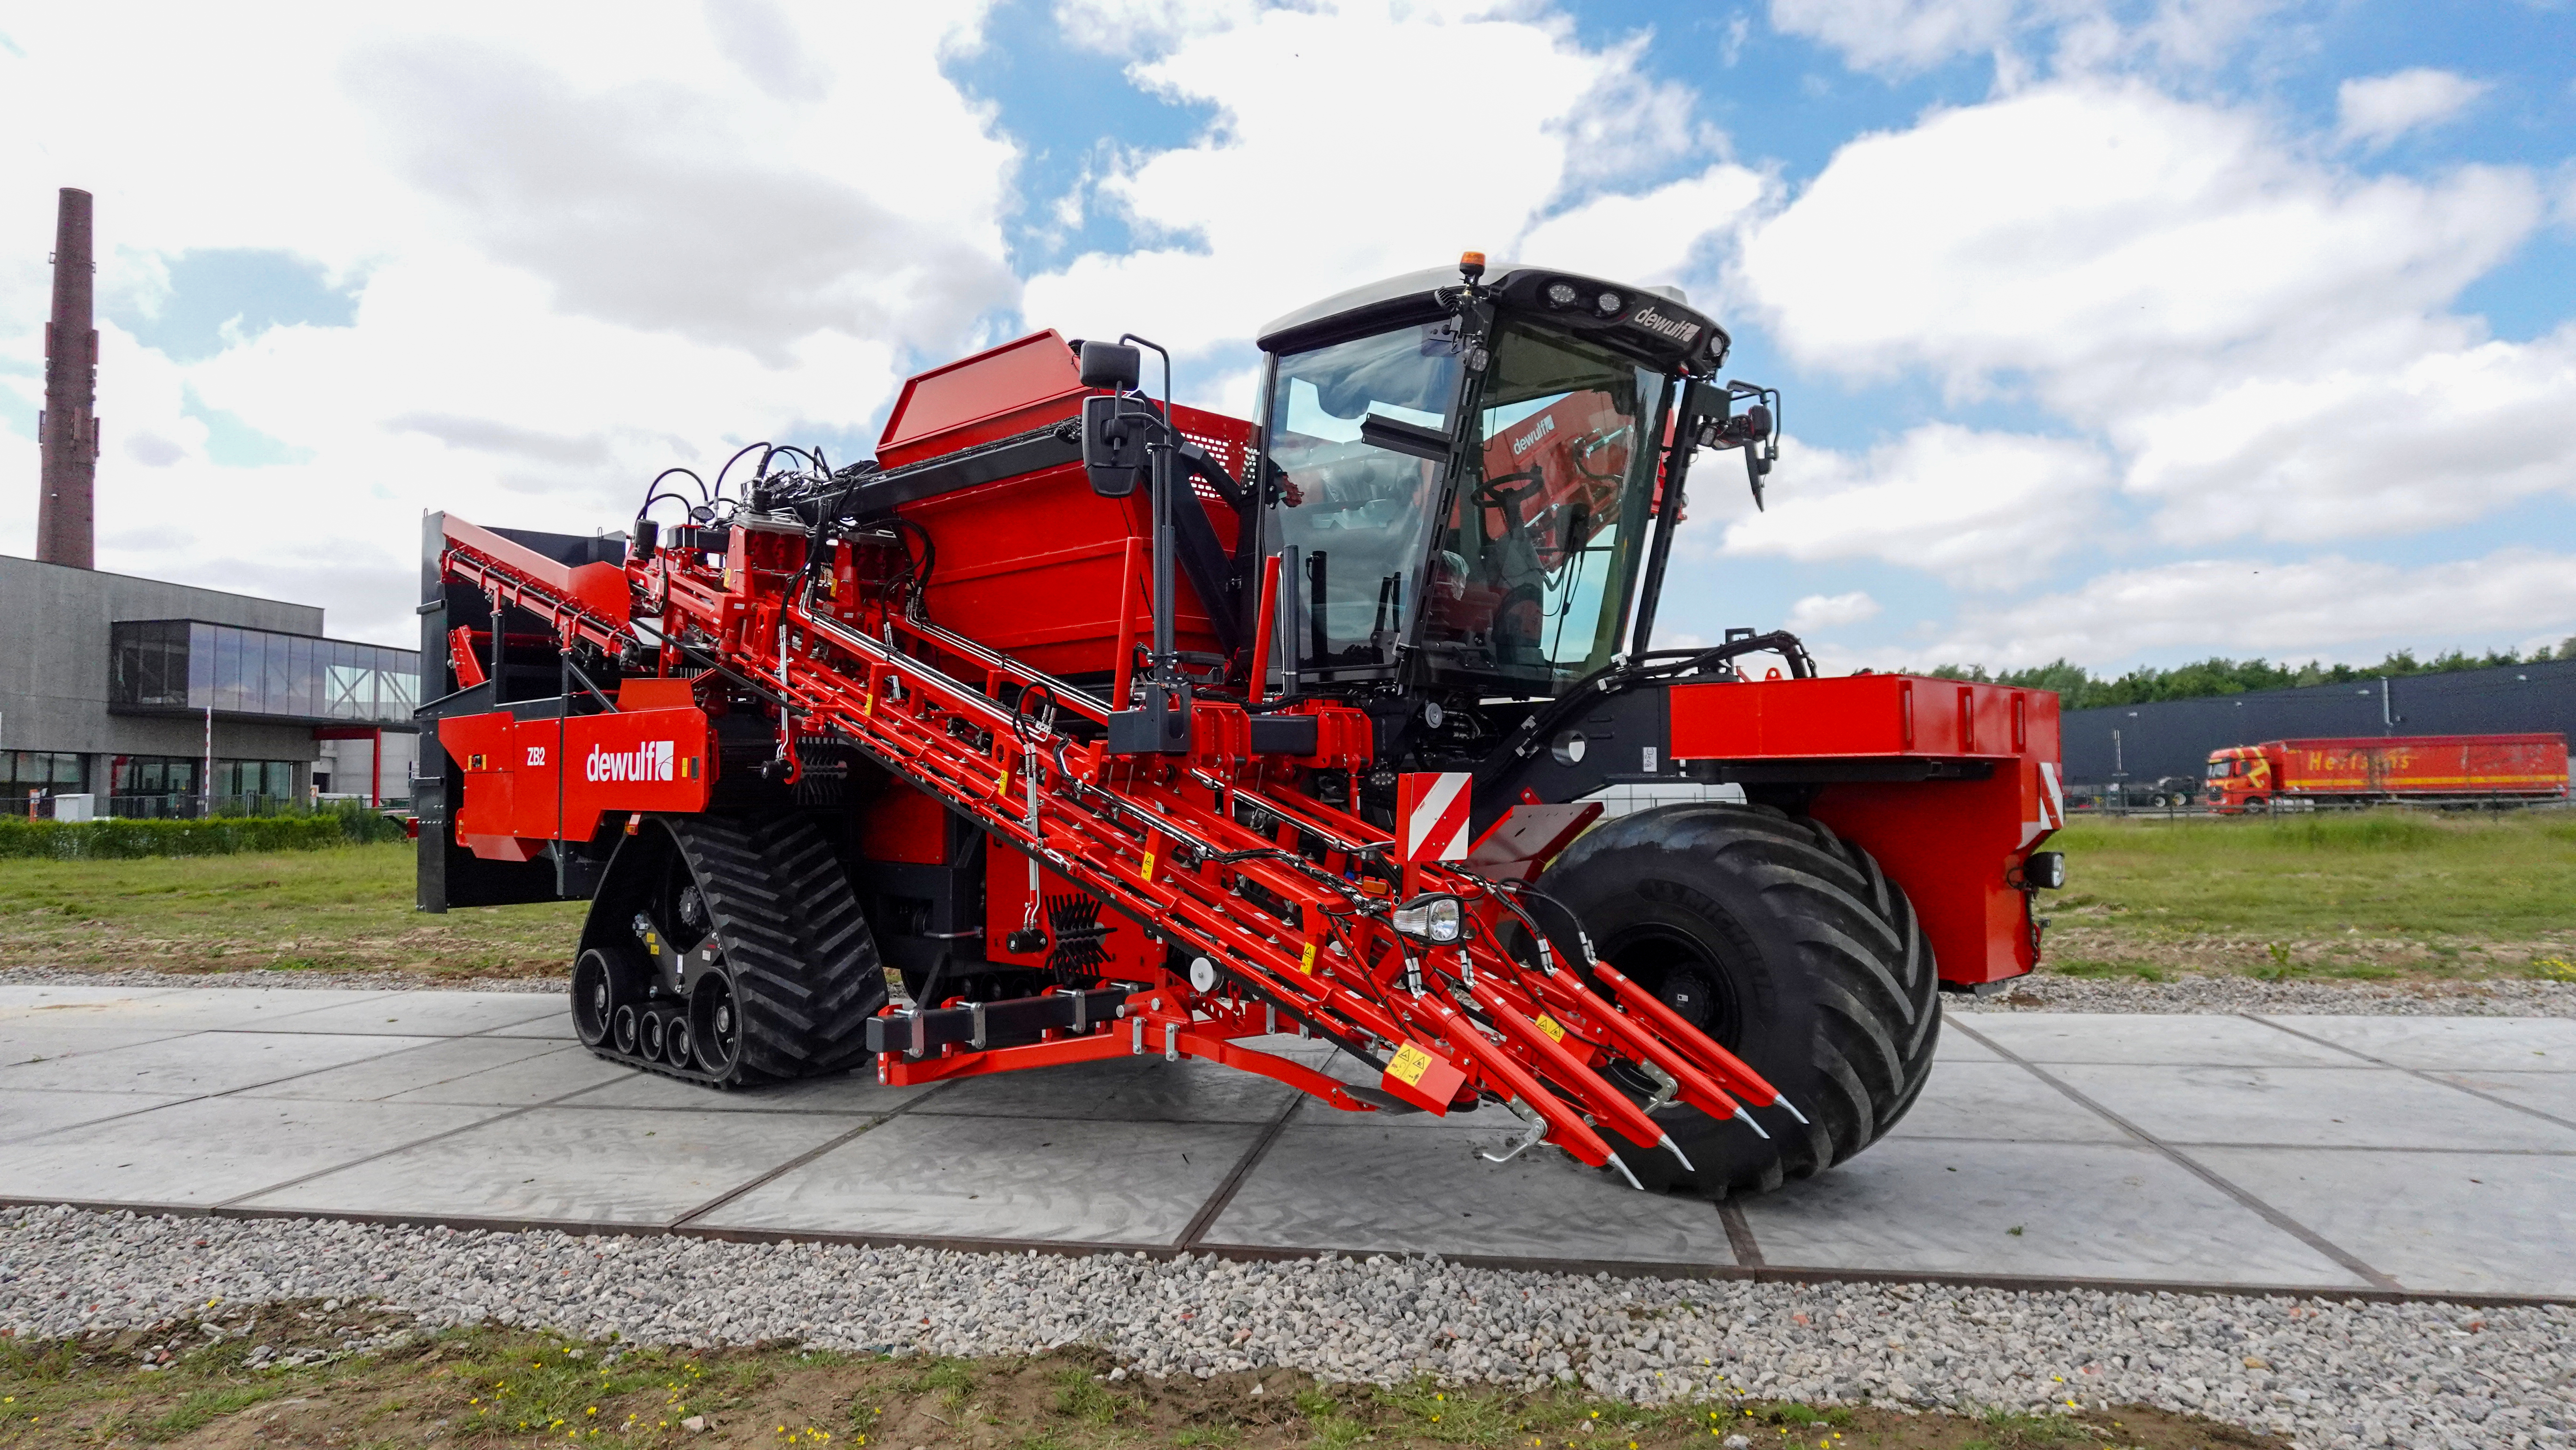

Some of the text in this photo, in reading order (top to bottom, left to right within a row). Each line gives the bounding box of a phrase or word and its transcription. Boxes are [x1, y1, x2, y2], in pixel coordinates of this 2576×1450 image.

[1634, 306, 1691, 339] dewulf
[1513, 419, 1546, 455] dewulf
[527, 747, 545, 766] ZB2
[587, 741, 655, 781] dewulf
